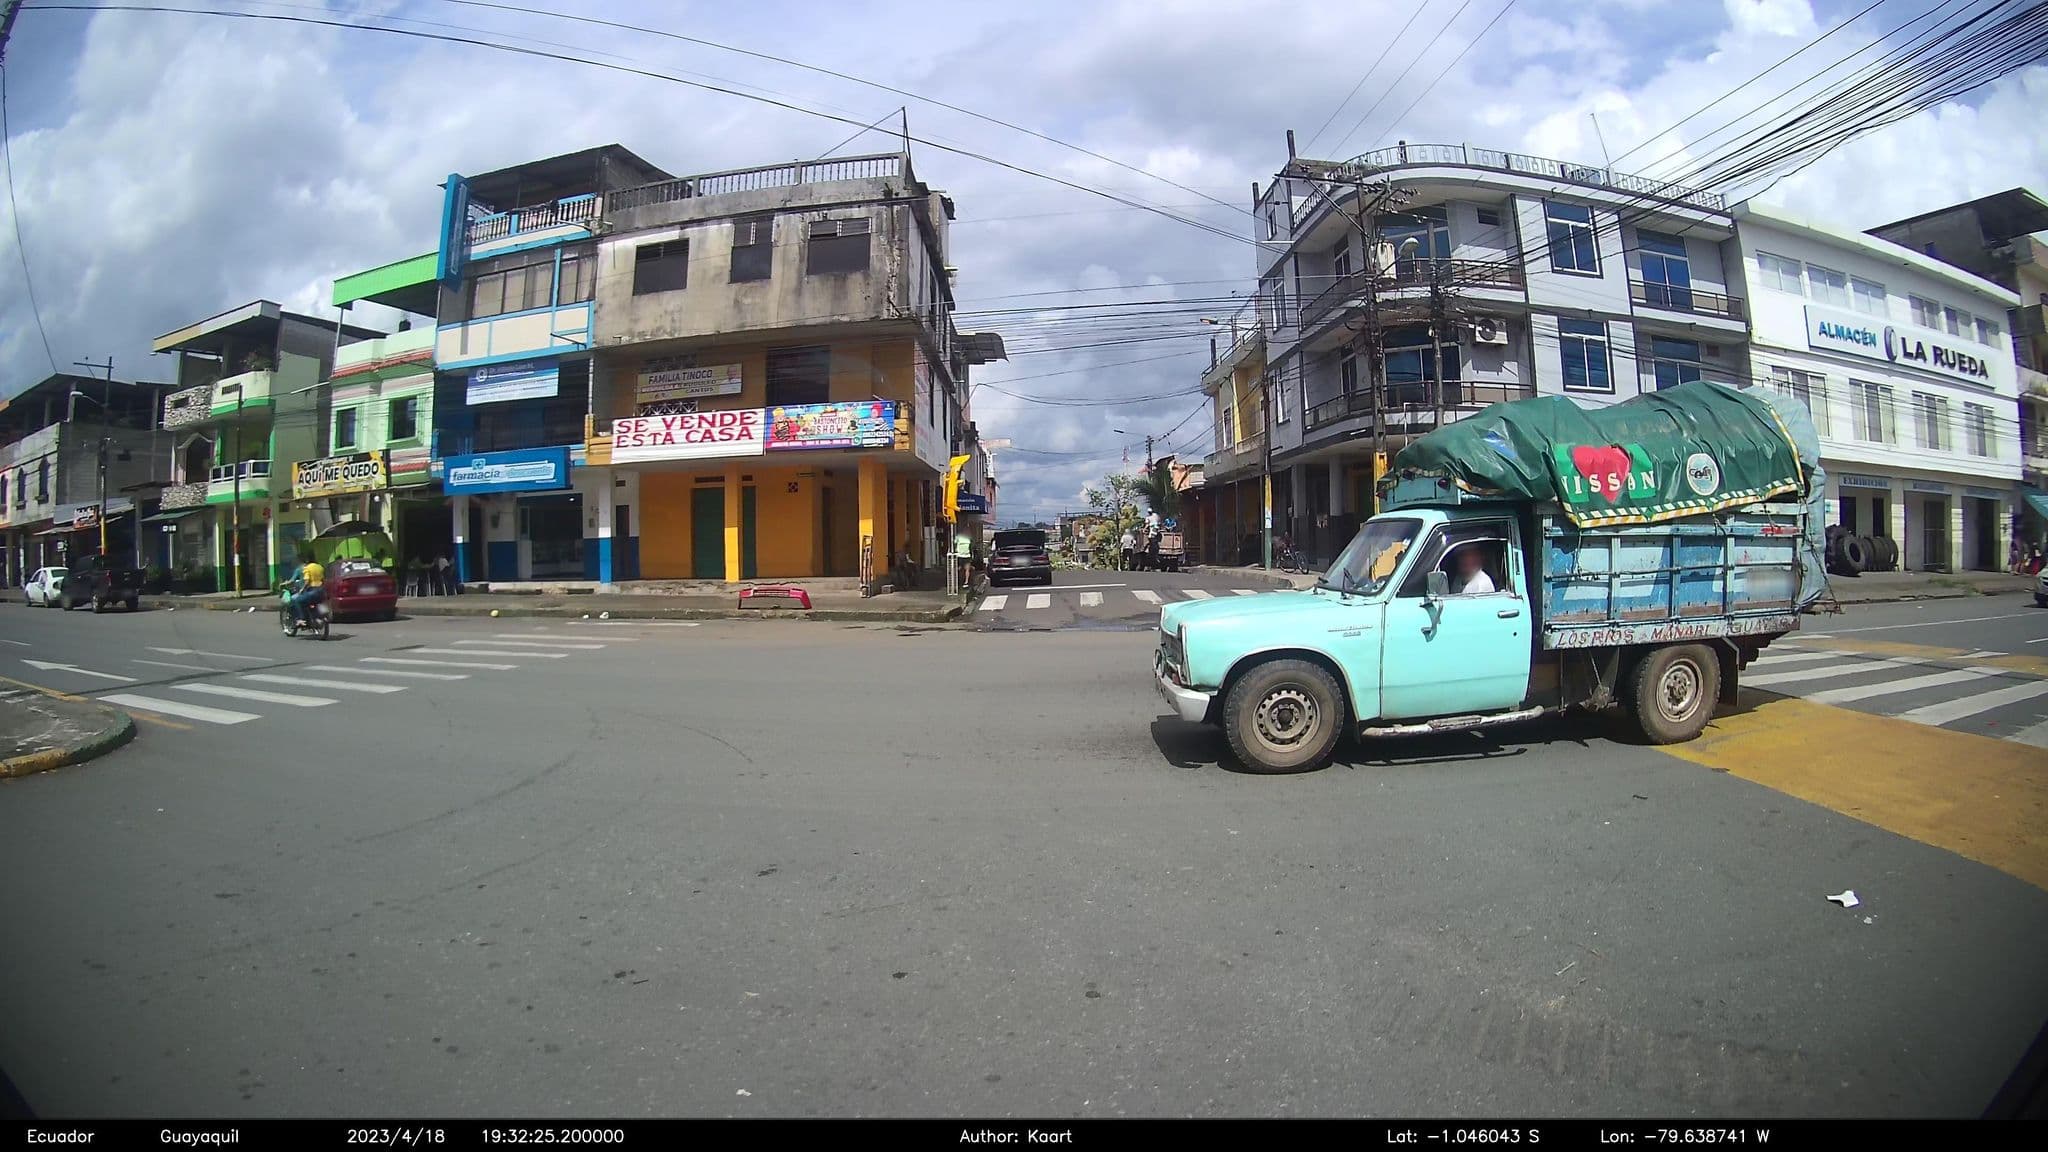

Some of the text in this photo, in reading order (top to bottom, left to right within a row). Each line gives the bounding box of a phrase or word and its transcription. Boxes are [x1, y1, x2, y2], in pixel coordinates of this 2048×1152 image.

[1818, 321, 1989, 379] ALMACÉN LA RUEDA
[648, 374, 680, 385] FAMILIA
[681, 369, 713, 381] TINOCO
[616, 411, 758, 434] SE VENDE
[816, 424, 842, 434] SHOW
[615, 432, 675, 448] ESTA
[685, 426, 754, 443] CASA
[325, 466, 339, 481] ME
[342, 462, 379, 479] QUEDO
[453, 468, 501, 481] farmacia
